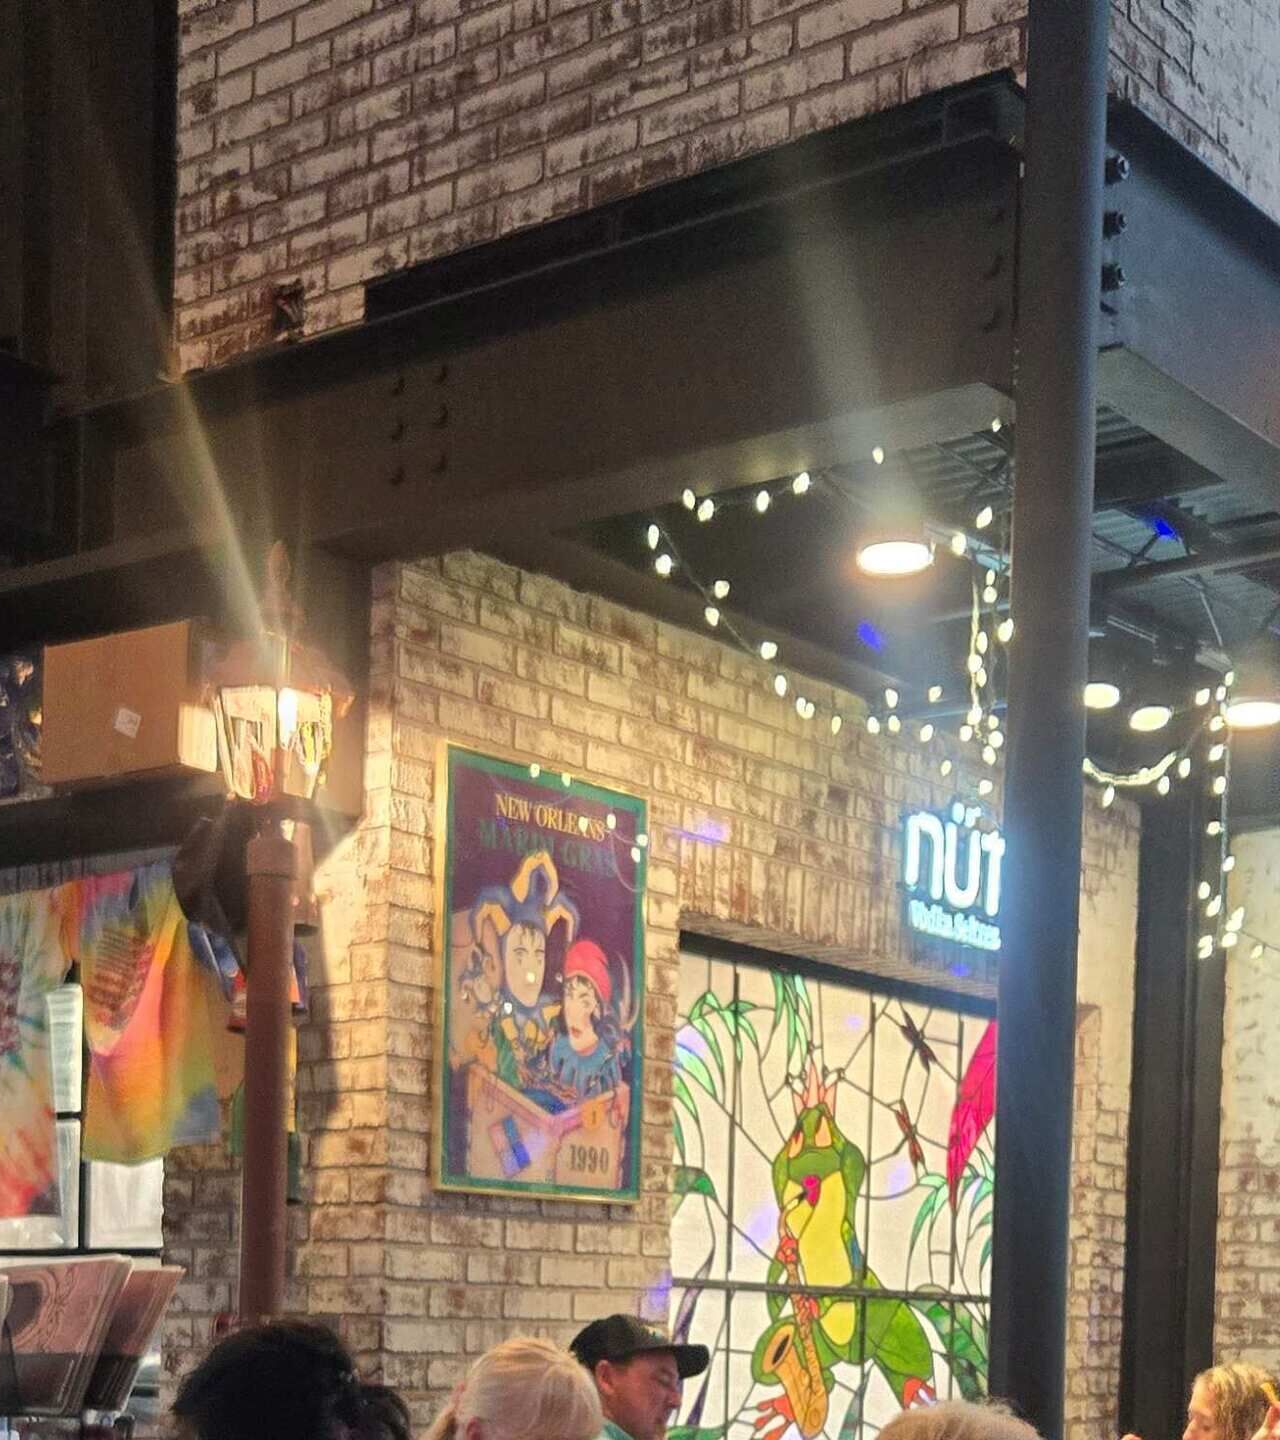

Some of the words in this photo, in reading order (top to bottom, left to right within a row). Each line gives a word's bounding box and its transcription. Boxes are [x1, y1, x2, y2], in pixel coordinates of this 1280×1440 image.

[495, 793, 531, 823] NEW
[535, 804, 605, 842] ORLENS
[569, 1144, 609, 1174] 1990
